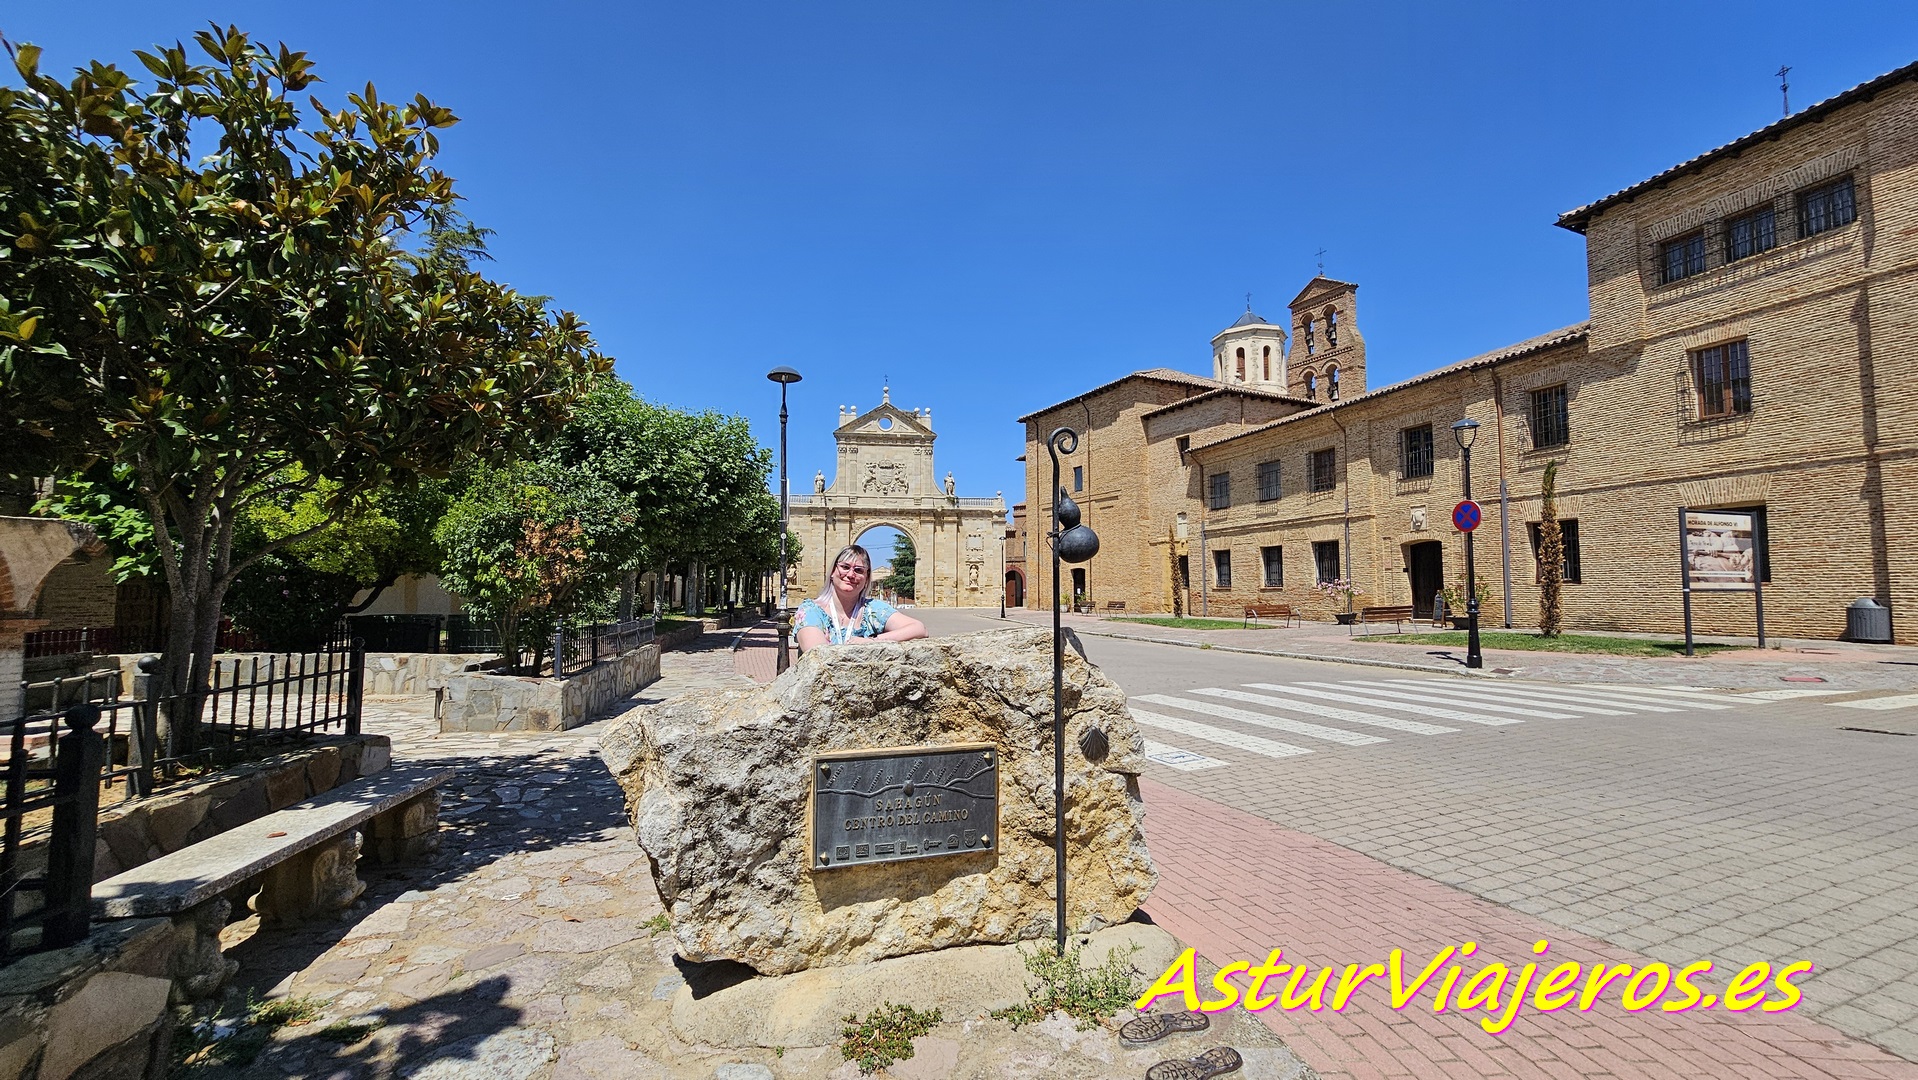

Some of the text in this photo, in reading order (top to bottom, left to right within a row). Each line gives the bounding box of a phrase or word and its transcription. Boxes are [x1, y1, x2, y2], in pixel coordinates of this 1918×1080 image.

[875, 792, 942, 812] SAHAGÚN
[844, 808, 969, 831] CENTRO DEL CAMINO
